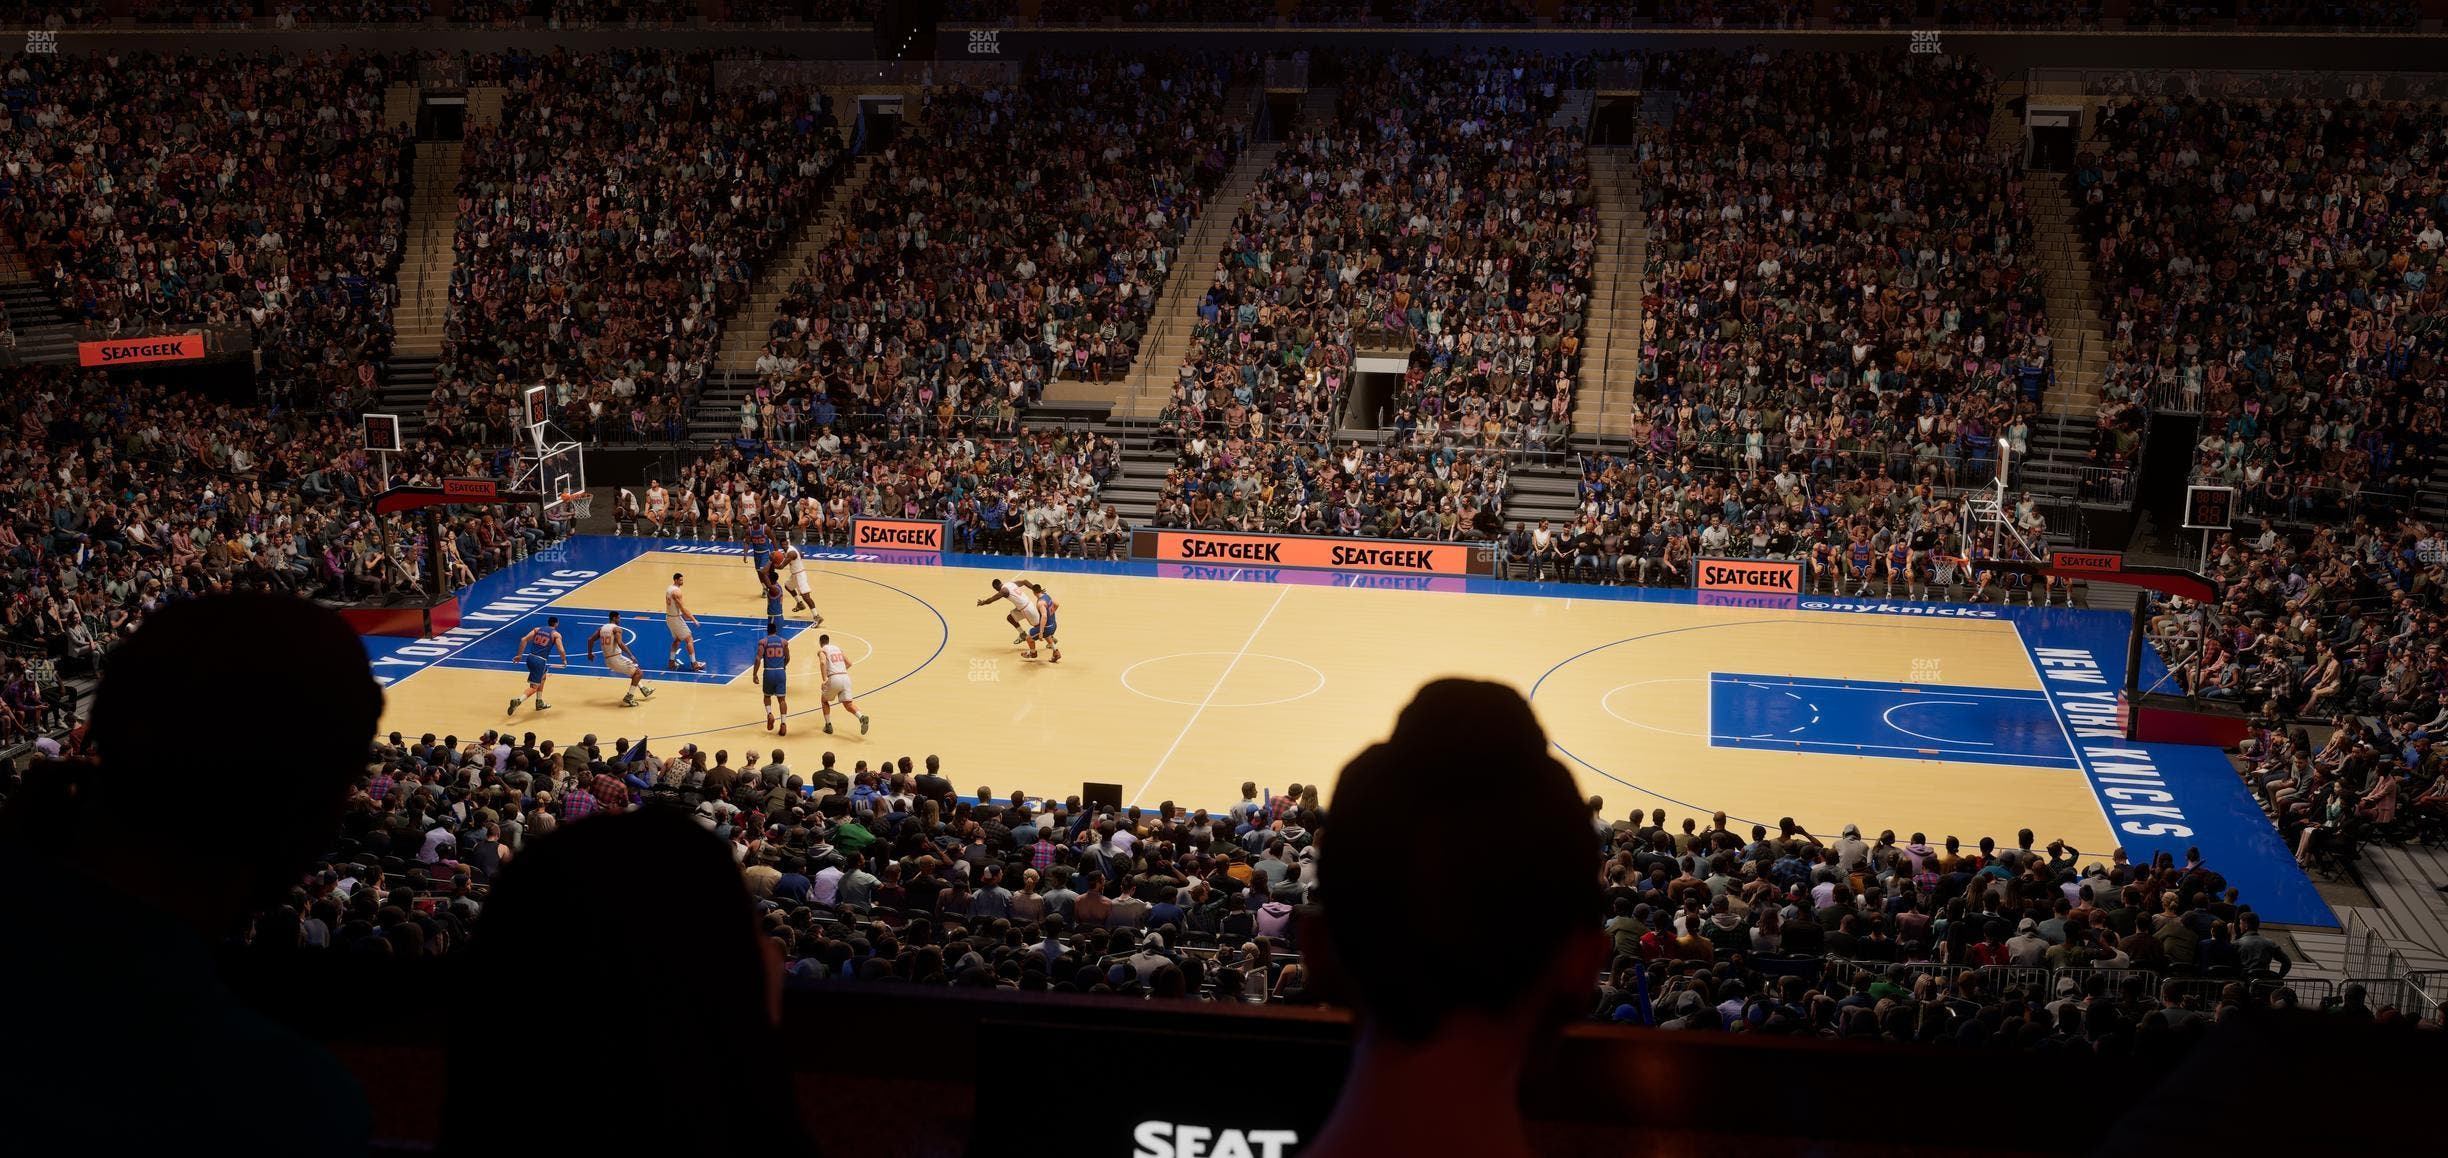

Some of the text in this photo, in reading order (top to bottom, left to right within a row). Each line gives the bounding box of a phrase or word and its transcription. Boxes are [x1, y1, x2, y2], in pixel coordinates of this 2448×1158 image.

[102, 342, 184, 361] SEATGEEK
[450, 482, 489, 493] SEATGEEK
[861, 526, 937, 547] SEATGEEK
[1182, 539, 1281, 562] SEATGEEK
[1332, 546, 1433, 570] SEATGEEK
[2060, 556, 2112, 568] SEATGEEK
[1705, 566, 1793, 589] SEATGEEK
[372, 569, 600, 666] YORK KNICKS
[1801, 601, 1997, 617] @nyknicks
[766, 648, 784, 658] 00
[2034, 647, 2194, 838] NEW YORK KNICKS
[1133, 1119, 1299, 1158] SEAT
